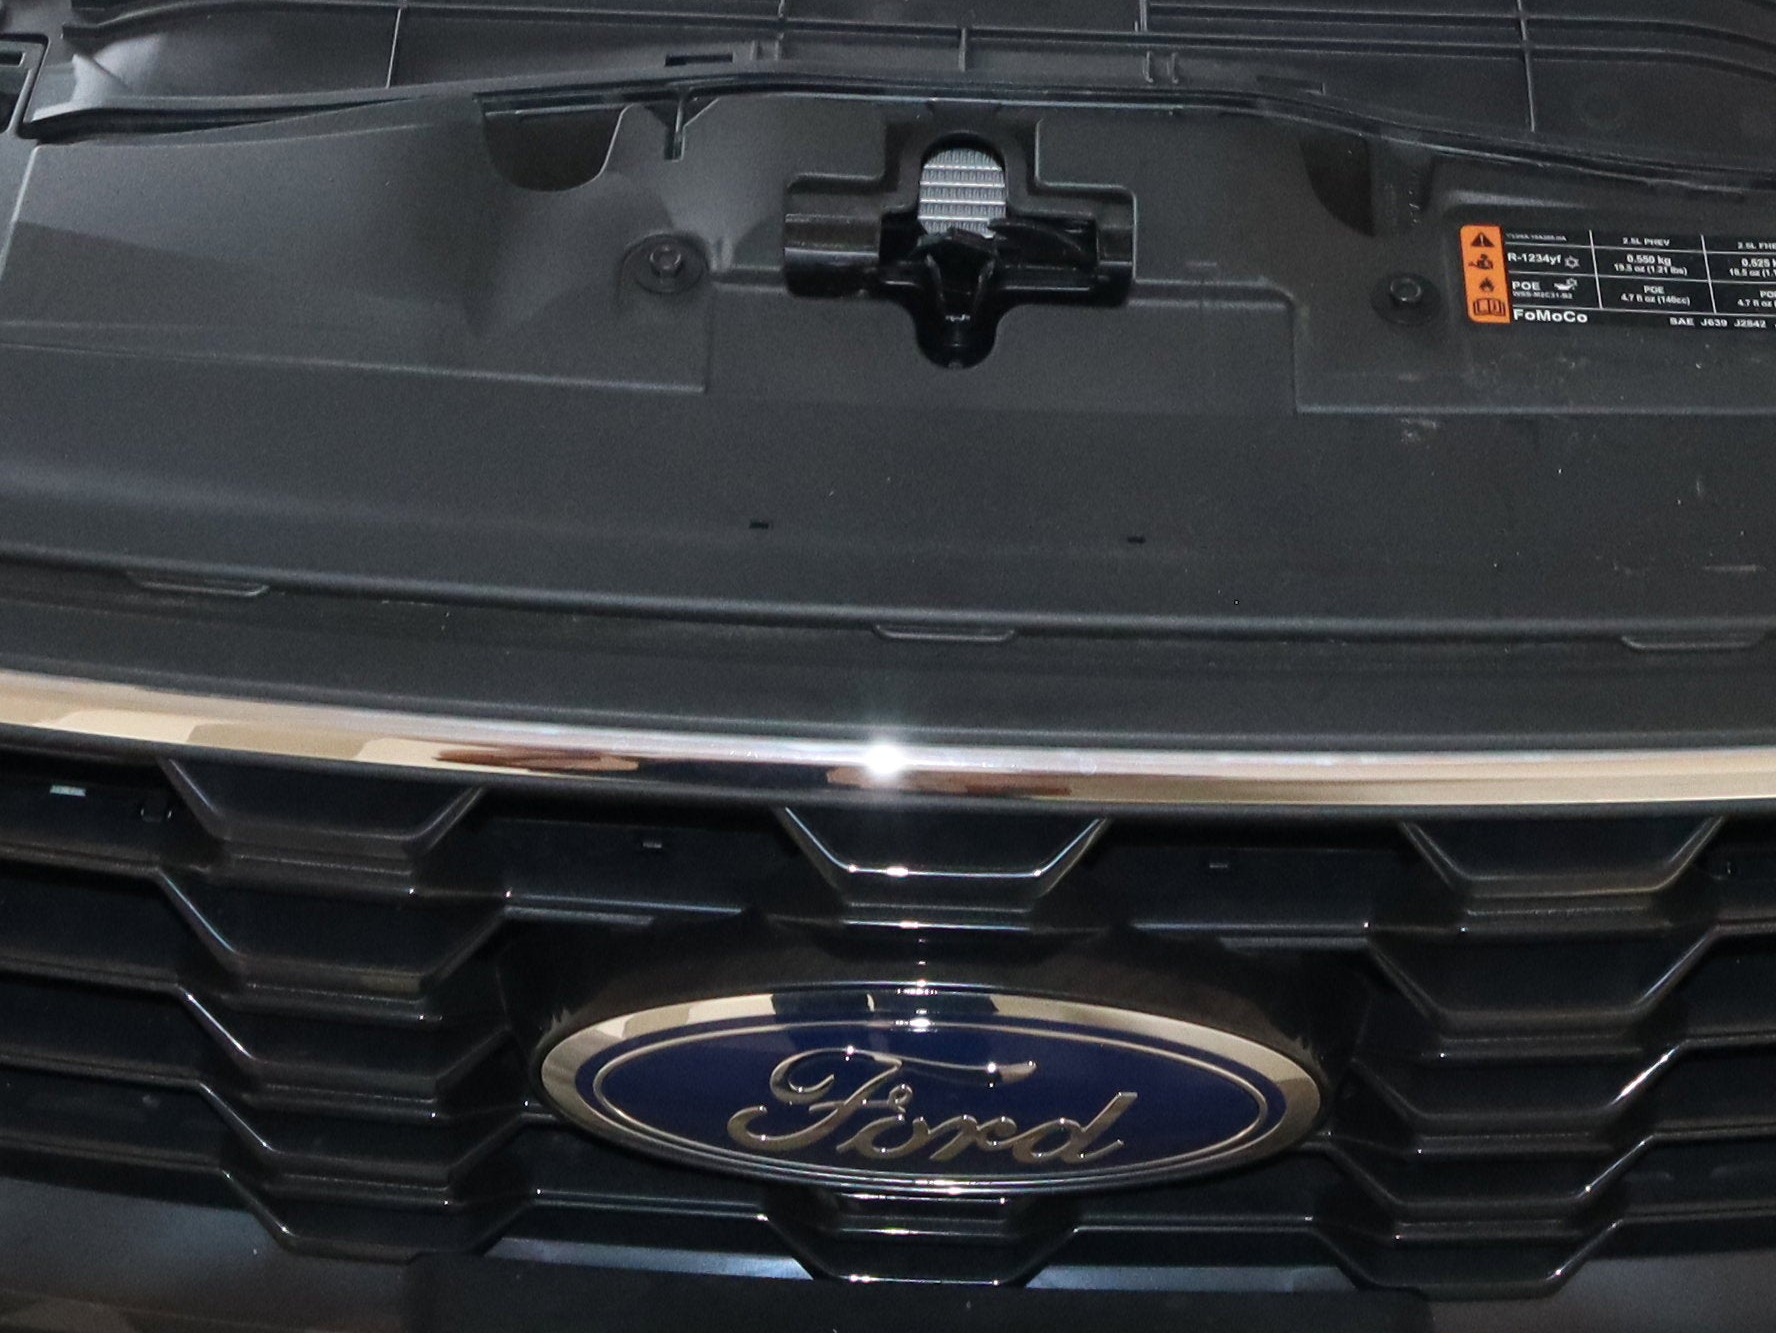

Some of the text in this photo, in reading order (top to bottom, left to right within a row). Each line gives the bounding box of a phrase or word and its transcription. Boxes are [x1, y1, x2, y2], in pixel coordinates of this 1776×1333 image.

[1507, 252, 1562, 264] R-1234yf
[1626, 253, 1672, 267] 0.550 kg
[1512, 281, 1541, 291] POE
[1513, 309, 1588, 323] FoMoCo
[727, 1047, 1138, 1164] Ford
